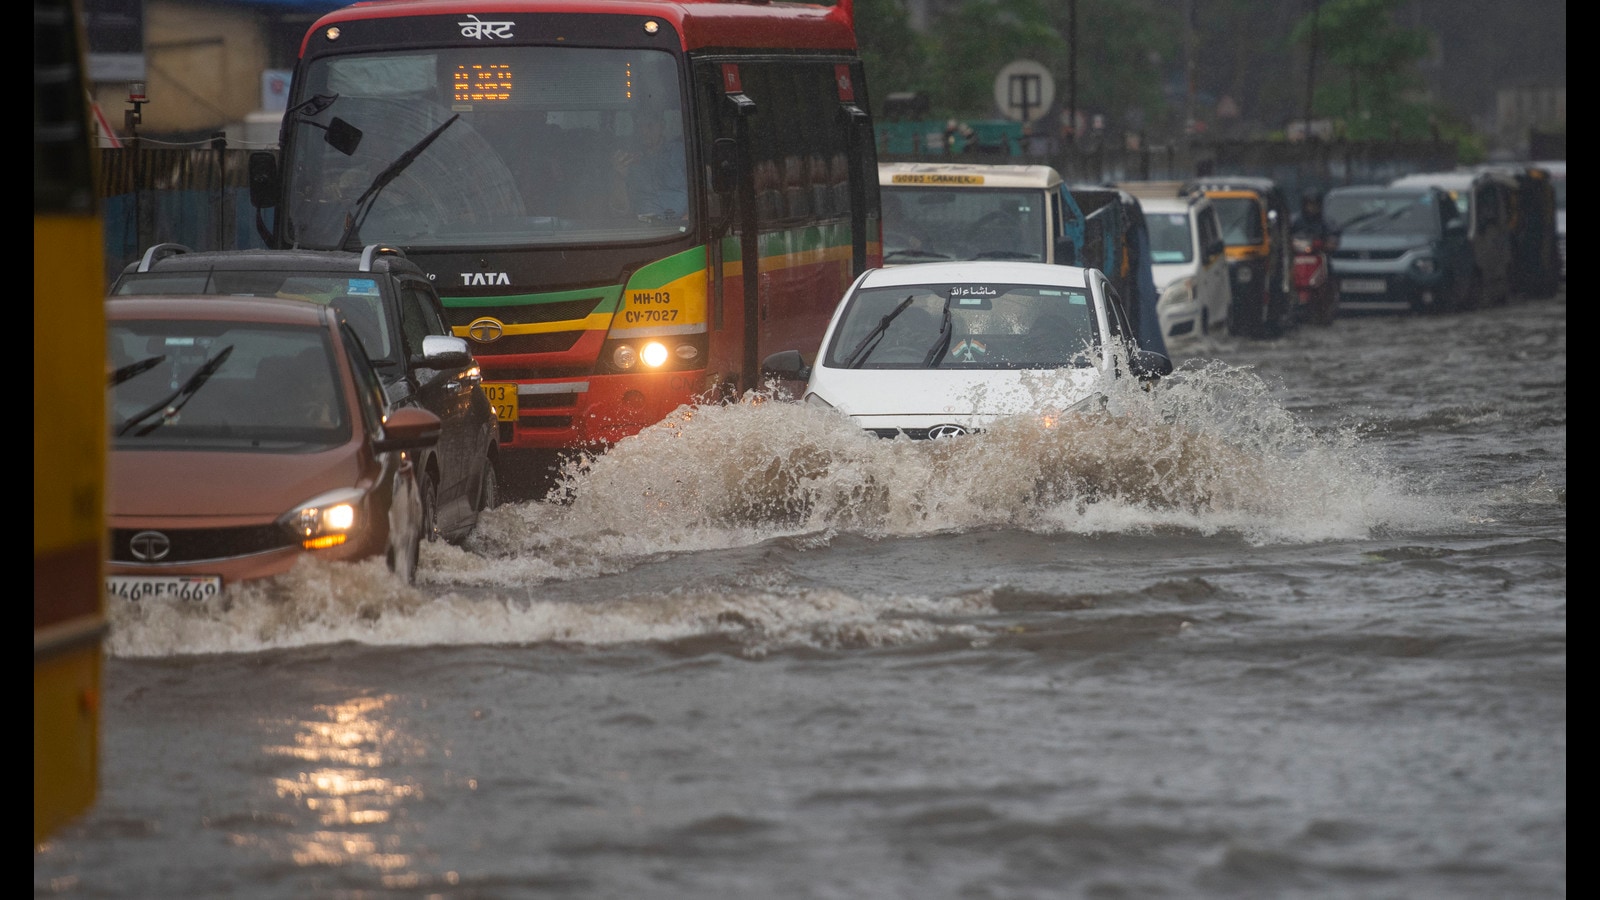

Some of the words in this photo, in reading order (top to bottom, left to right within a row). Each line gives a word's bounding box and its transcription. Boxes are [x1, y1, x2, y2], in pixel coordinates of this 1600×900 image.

[458, 14, 516, 40] बेस्ट
[895, 174, 924, 183] GOODS
[461, 272, 511, 286] TATA
[633, 292, 671, 305] MH-03
[625, 309, 679, 323] CV-7027
